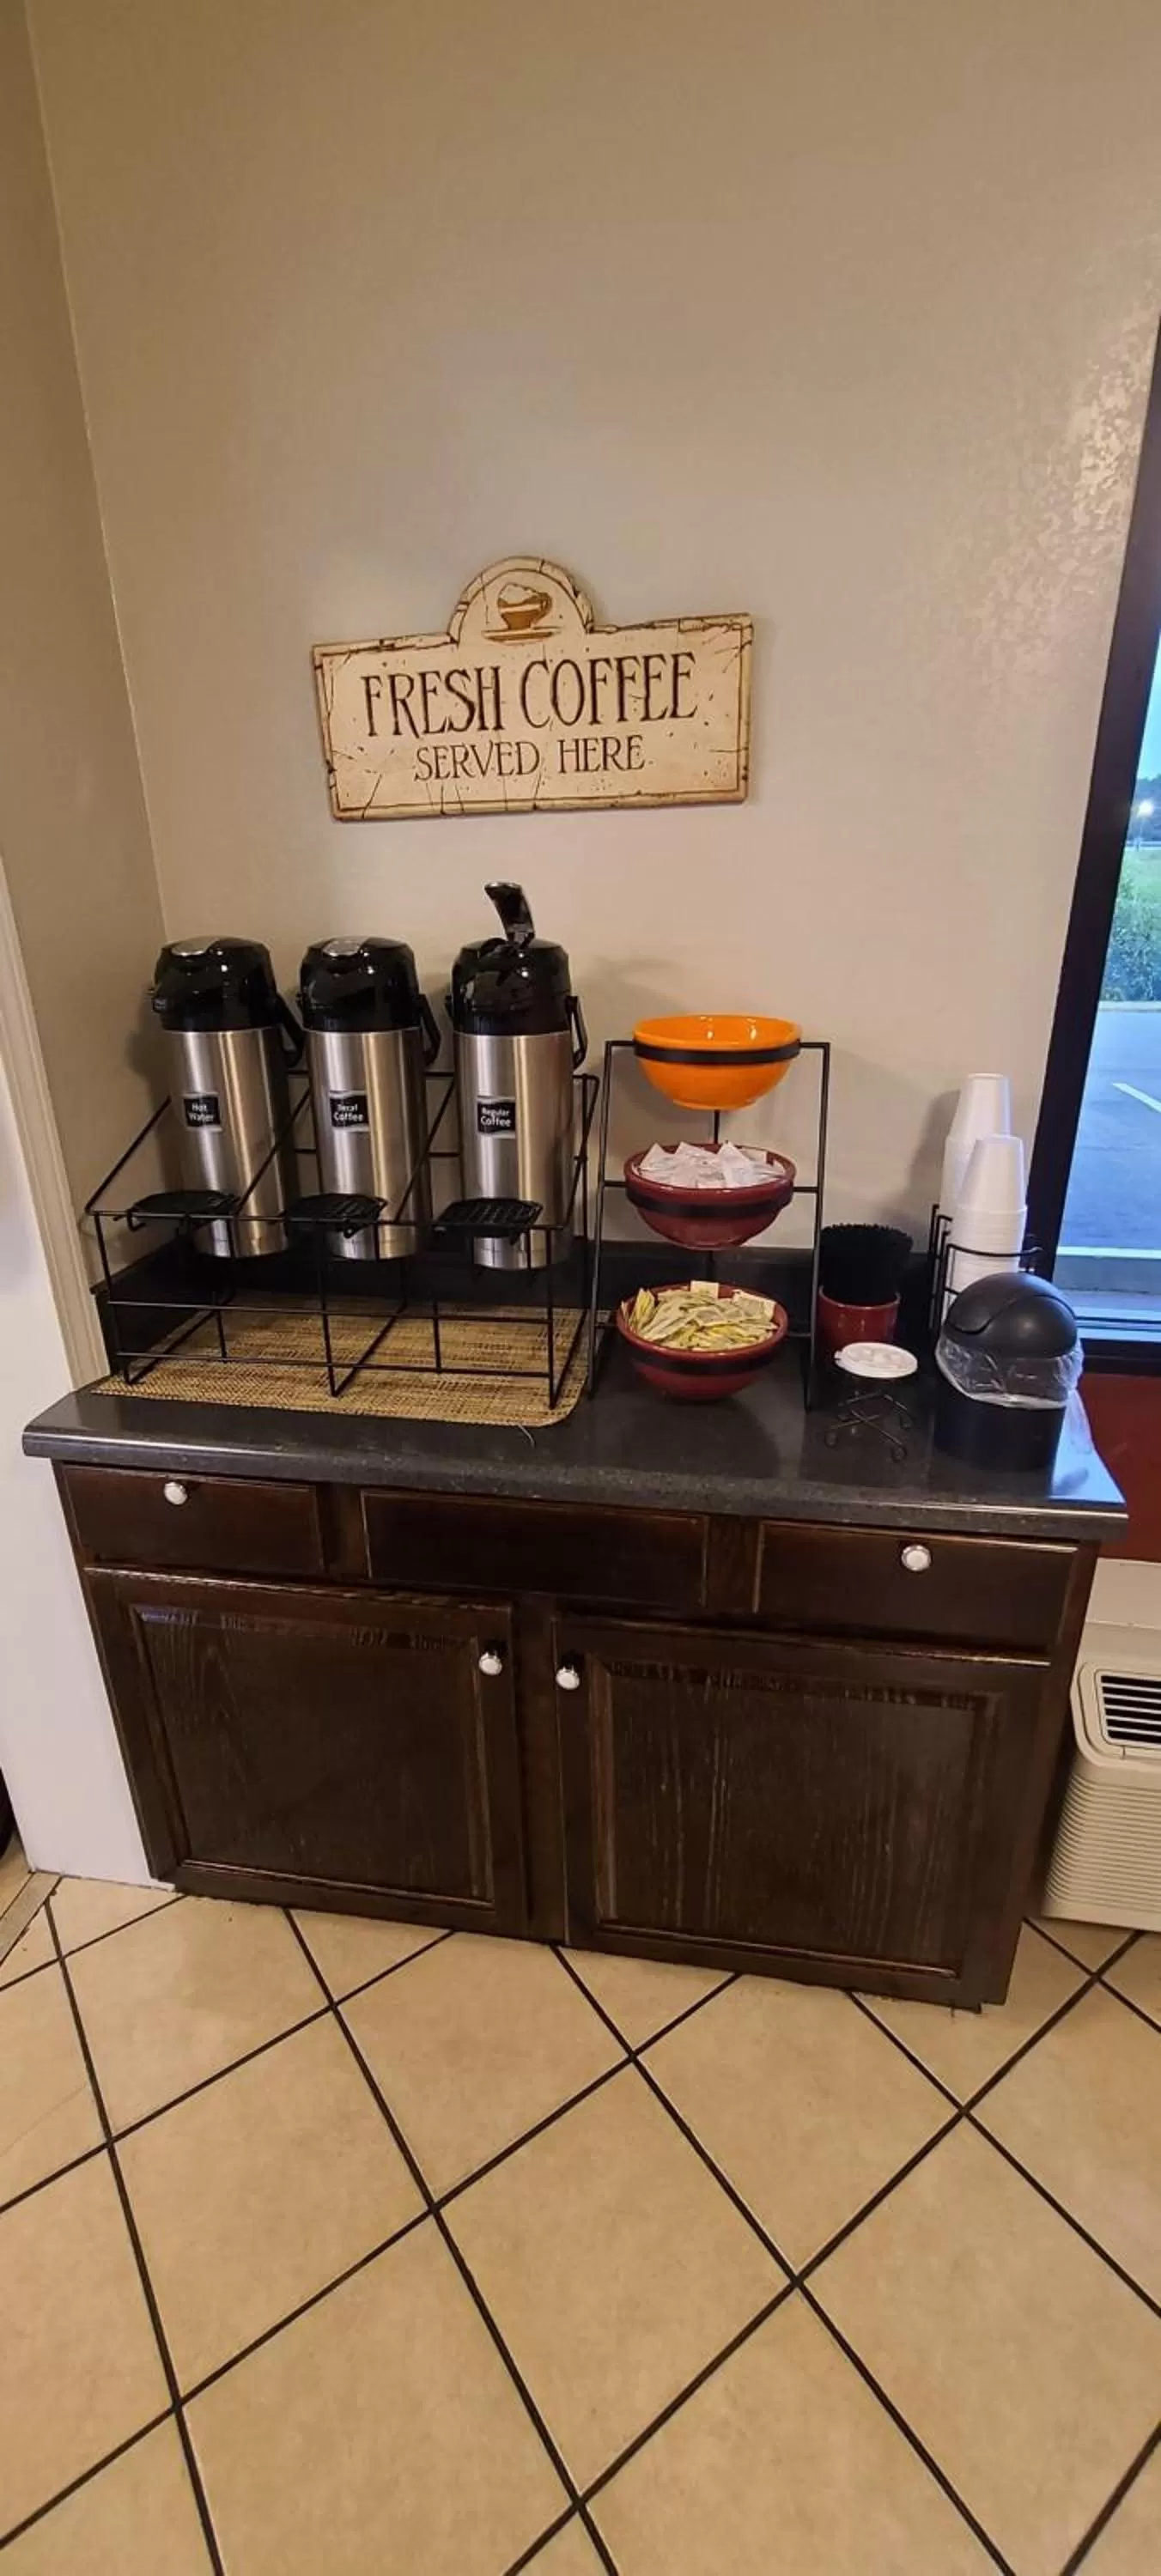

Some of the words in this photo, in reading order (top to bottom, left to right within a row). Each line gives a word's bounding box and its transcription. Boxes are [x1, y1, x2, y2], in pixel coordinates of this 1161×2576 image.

[361, 665, 506, 739] FRESH
[520, 651, 698, 729] COFFEE
[414, 739, 540, 782] SERVED
[557, 734, 646, 774] HERE
[333, 1112, 363, 1121] Coffee
[481, 1115, 511, 1127] Coffee
